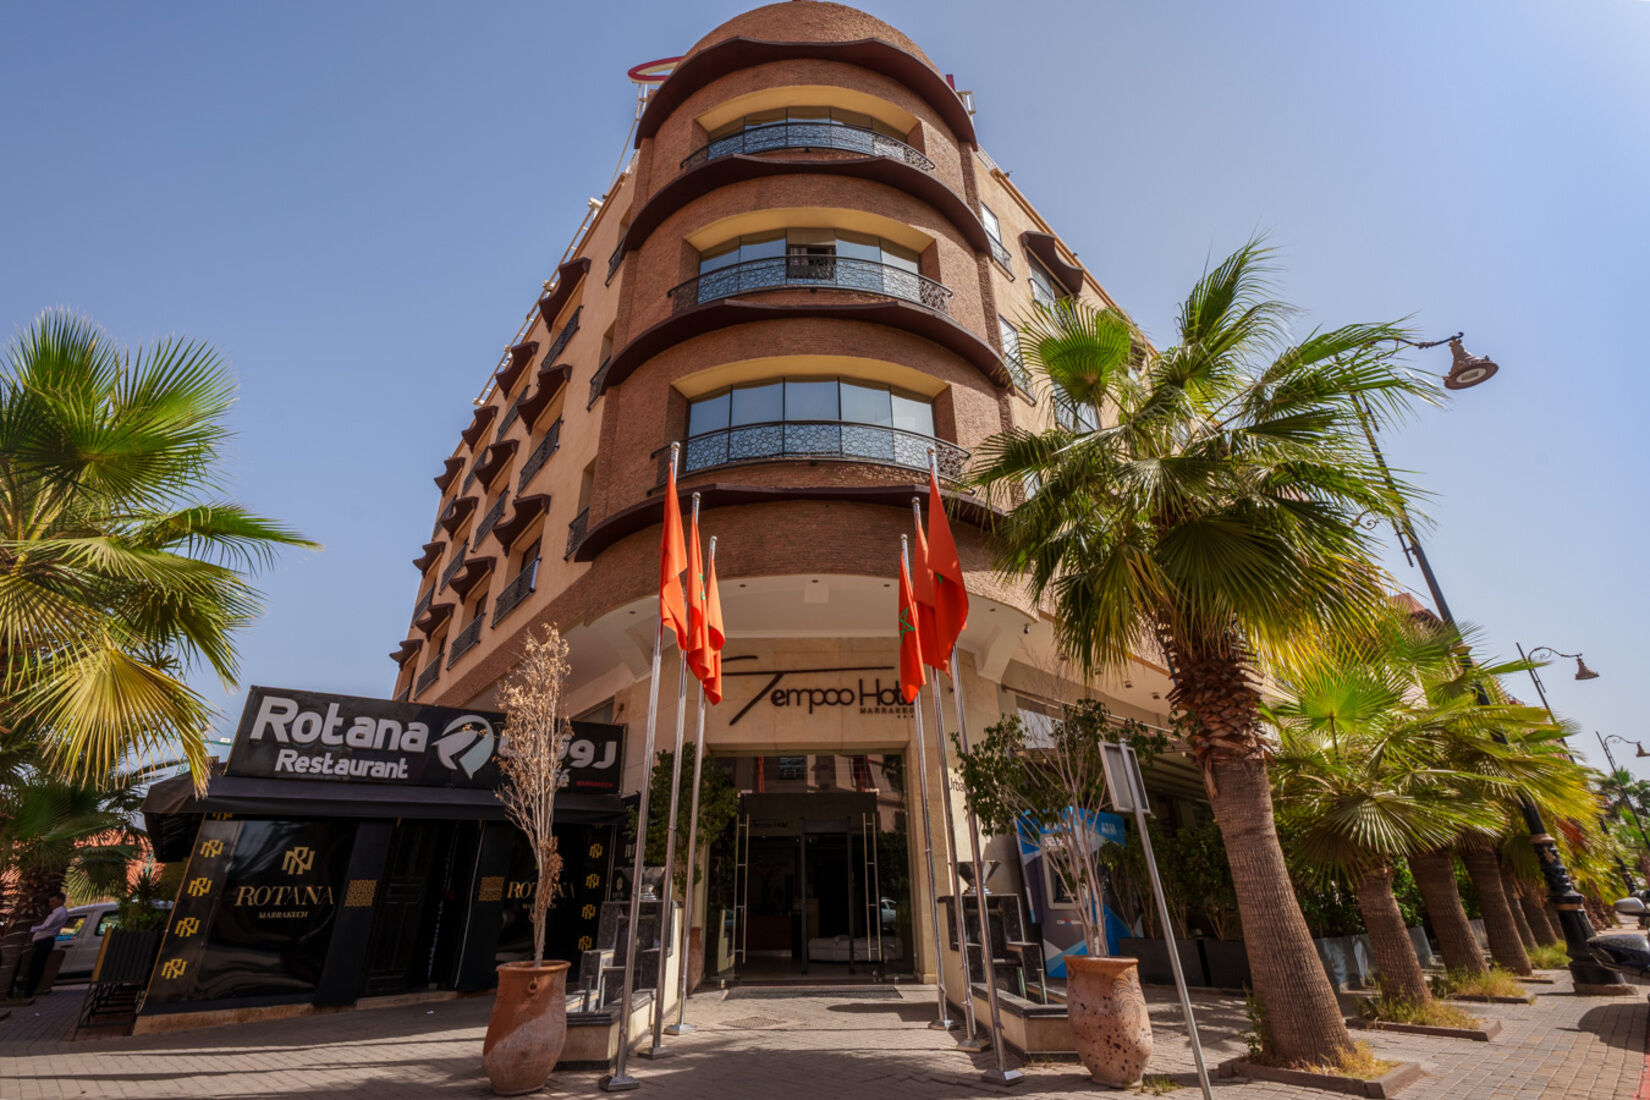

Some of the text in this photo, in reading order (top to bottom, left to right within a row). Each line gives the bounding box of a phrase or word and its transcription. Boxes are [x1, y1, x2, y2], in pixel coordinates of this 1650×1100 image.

[721, 655, 914, 726] Tempoo Hot
[249, 696, 429, 753] Rotana
[275, 749, 408, 779] Restaurant
[234, 886, 334, 906] ROTANA
[258, 911, 308, 919] MARRAKECH
